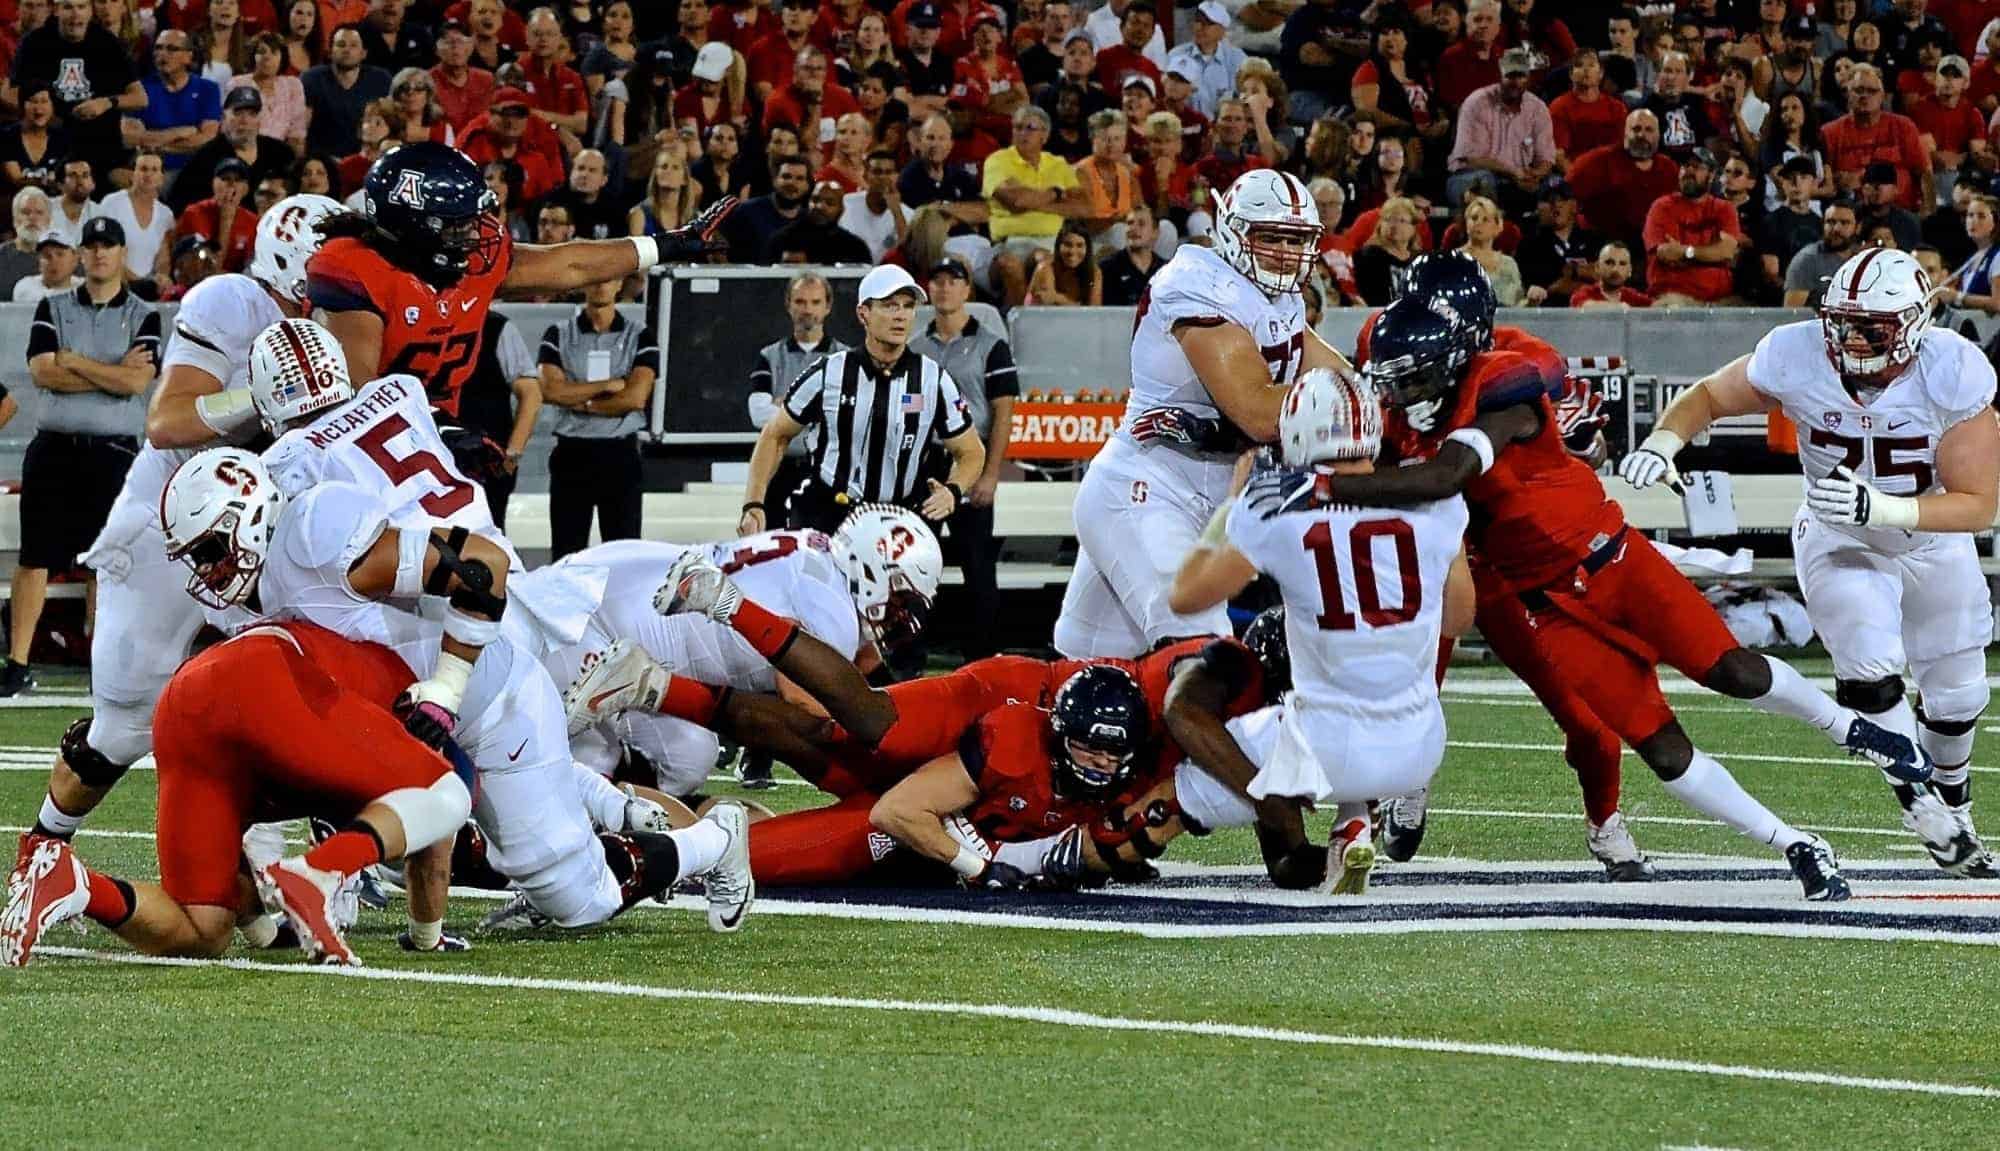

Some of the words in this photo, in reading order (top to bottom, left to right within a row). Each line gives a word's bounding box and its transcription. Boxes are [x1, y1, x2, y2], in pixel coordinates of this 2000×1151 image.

[388, 168, 425, 210] A
[299, 391, 341, 412] Riddell
[1601, 375, 1622, 401] 19
[901, 433, 915, 449] R
[1009, 414, 1126, 443] GATORA
[352, 412, 474, 519] 5
[1810, 427, 1934, 498] 75
[1302, 517, 1423, 630] 10
